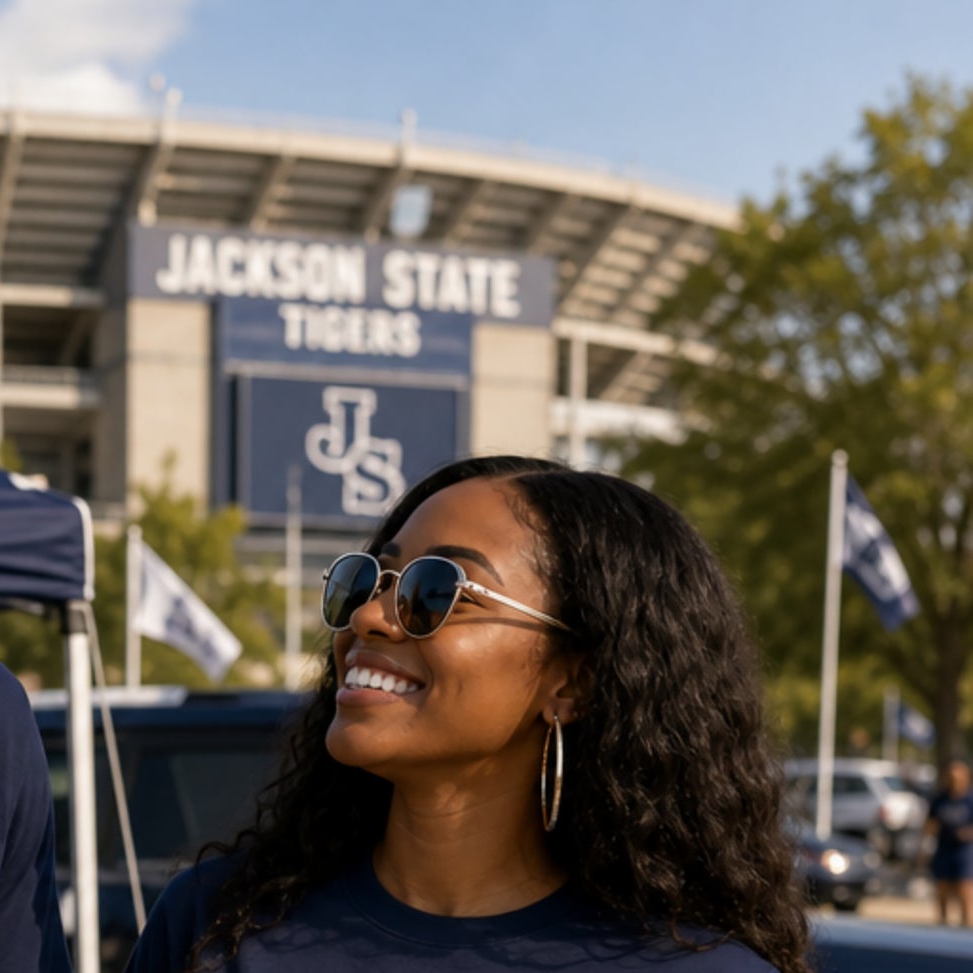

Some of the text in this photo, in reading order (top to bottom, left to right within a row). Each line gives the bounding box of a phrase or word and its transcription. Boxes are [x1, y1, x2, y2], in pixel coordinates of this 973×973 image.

[156, 232, 521, 319] JACKSON STATE
[278, 303, 422, 358] TIGERS
